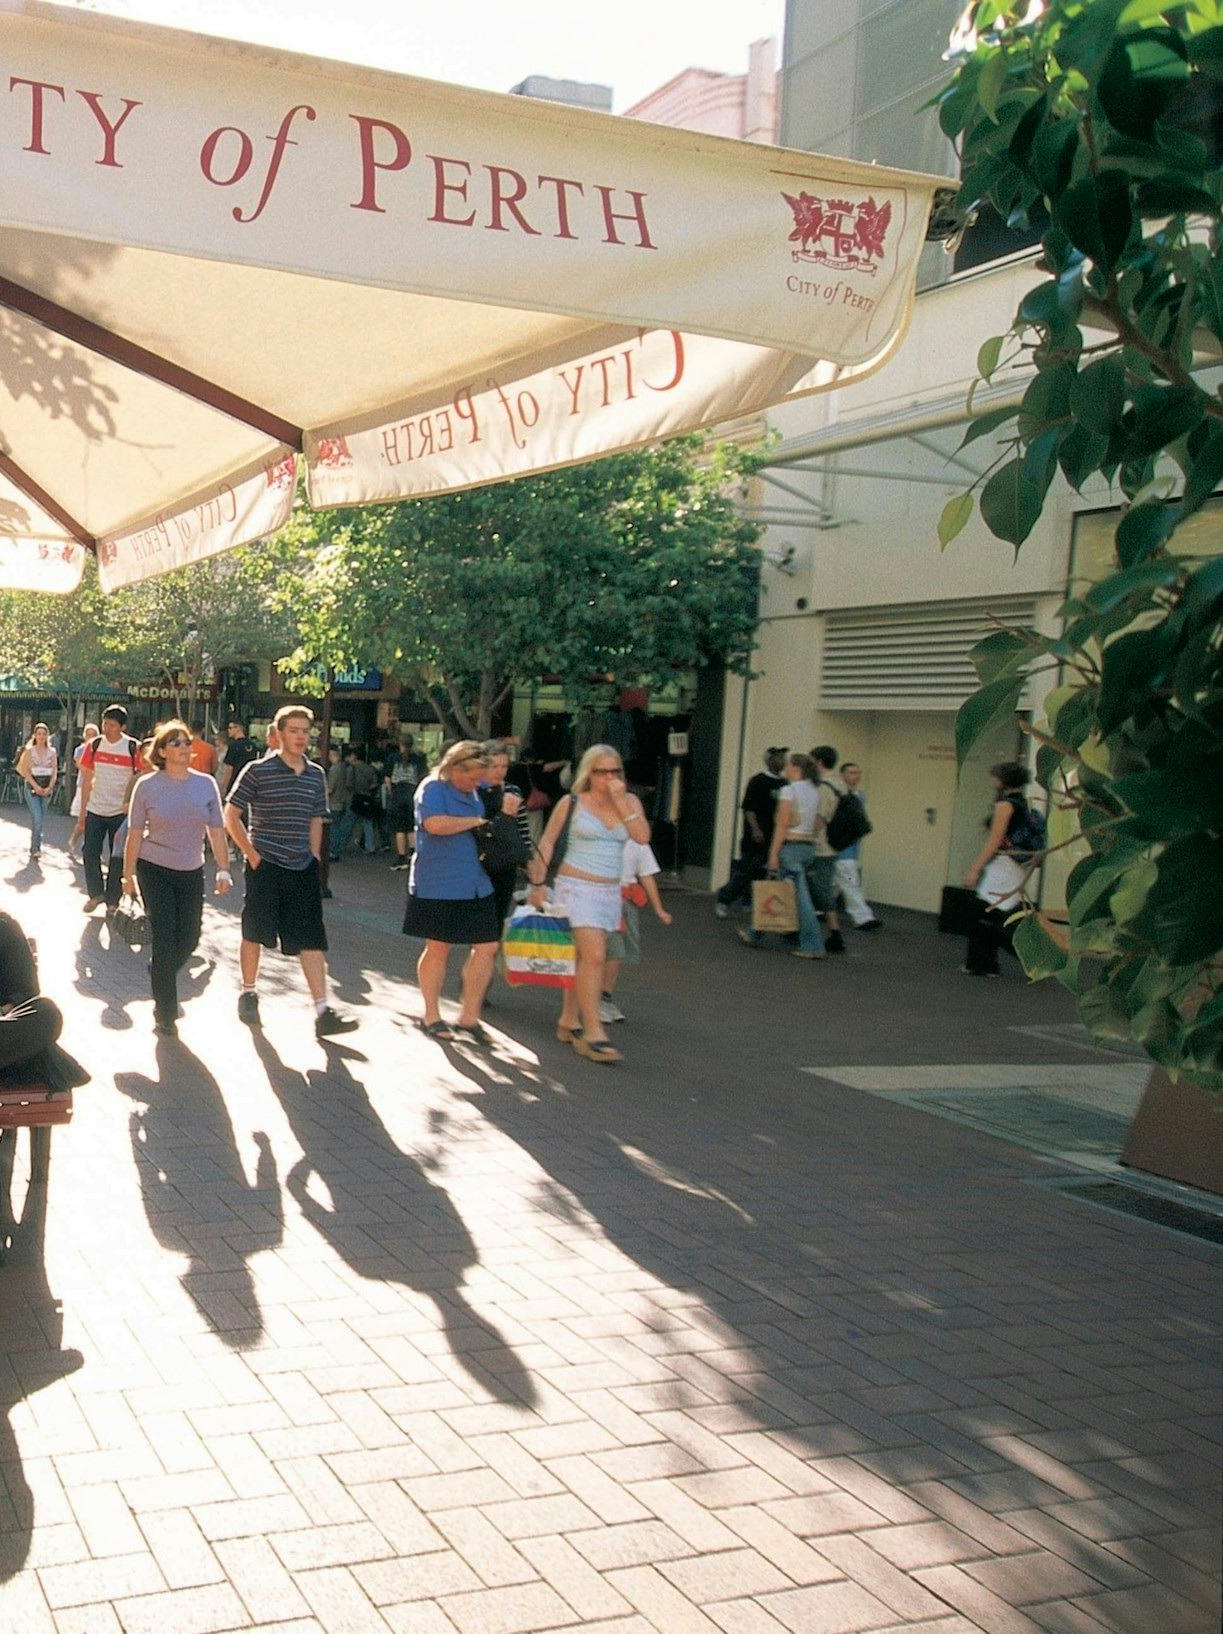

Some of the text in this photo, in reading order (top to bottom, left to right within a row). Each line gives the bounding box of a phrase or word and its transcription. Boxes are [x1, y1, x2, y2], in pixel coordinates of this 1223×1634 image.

[199, 105, 317, 224] of
[823, 281, 844, 306] of
[126, 685, 211, 700] McDonad's
